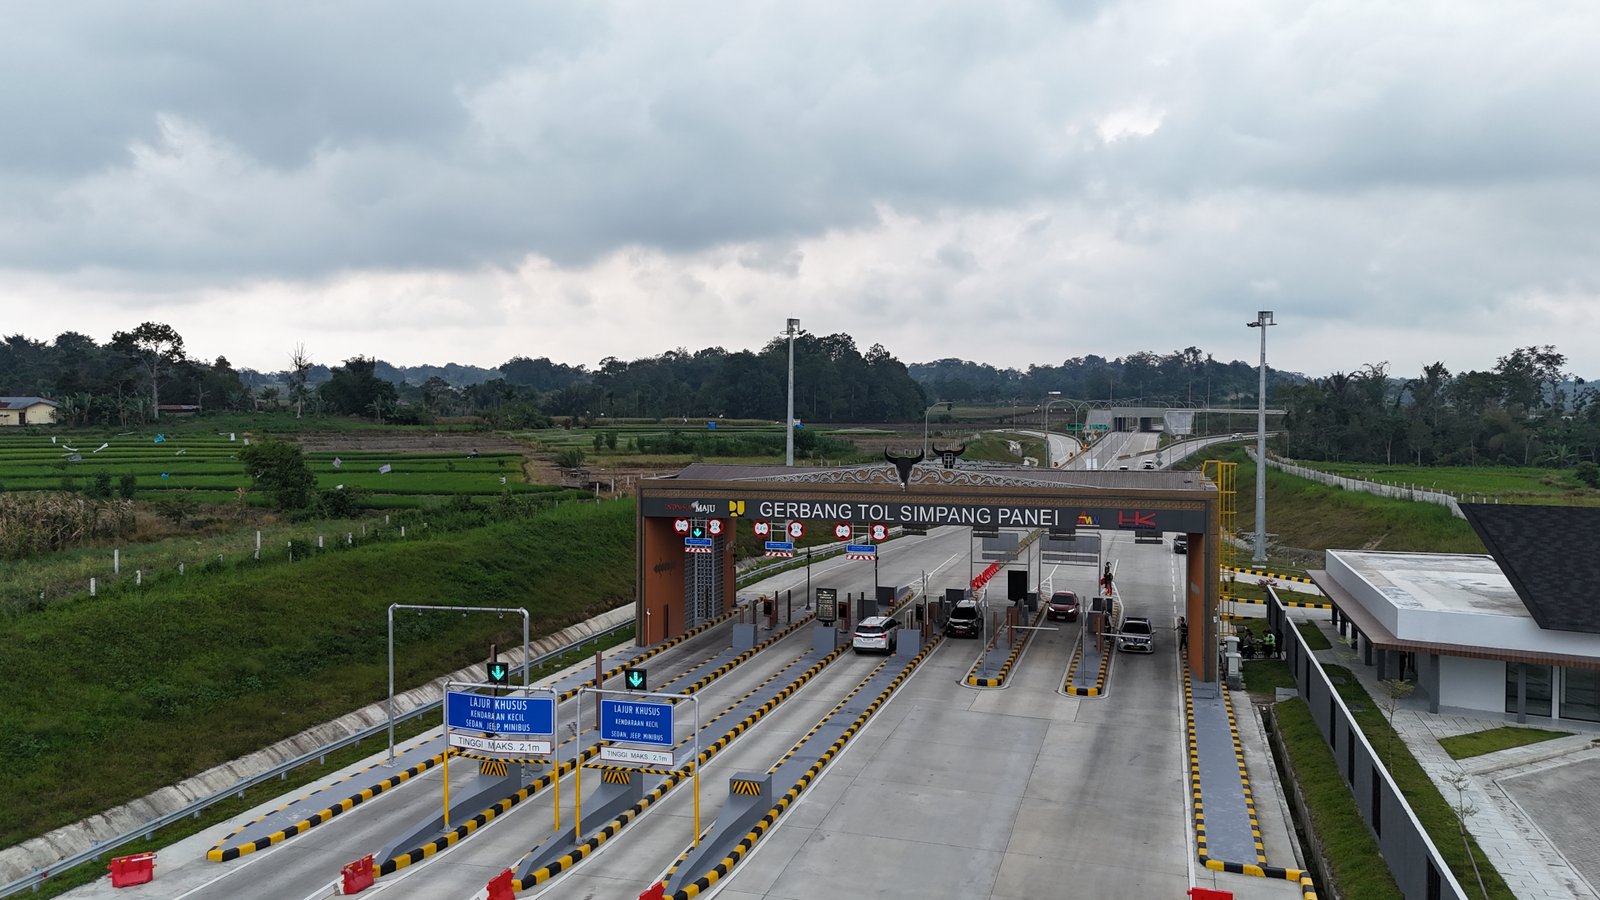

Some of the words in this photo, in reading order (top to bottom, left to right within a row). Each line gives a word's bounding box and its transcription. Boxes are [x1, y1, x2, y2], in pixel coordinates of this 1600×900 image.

[696, 504, 716, 514] MAJU
[760, 502, 852, 518] GERBANG
[858, 504, 894, 520] TOL
[900, 506, 991, 524] SIMPANG
[998, 508, 1059, 526] PANEI
[1118, 511, 1157, 526] HK
[470, 697, 491, 709] LAJUR
[495, 700, 528, 711] KHUSUS
[614, 704, 633, 714] LAJUR
[635, 706, 660, 716] KHUSUS
[470, 710, 505, 721] KENDARAAN
[507, 714, 524, 722] KECIL
[466, 719, 484, 730] SEDAN,
[504, 722, 530, 732] MINIBUS
[615, 718, 644, 727] KENDARAAN
[611, 730, 628, 739] SEDAN,
[643, 733, 664, 741] MINIBUS
[458, 737, 484, 748] TINGGI
[488, 740, 516, 751] MAKS.
[520, 743, 540, 752] 2,1m
